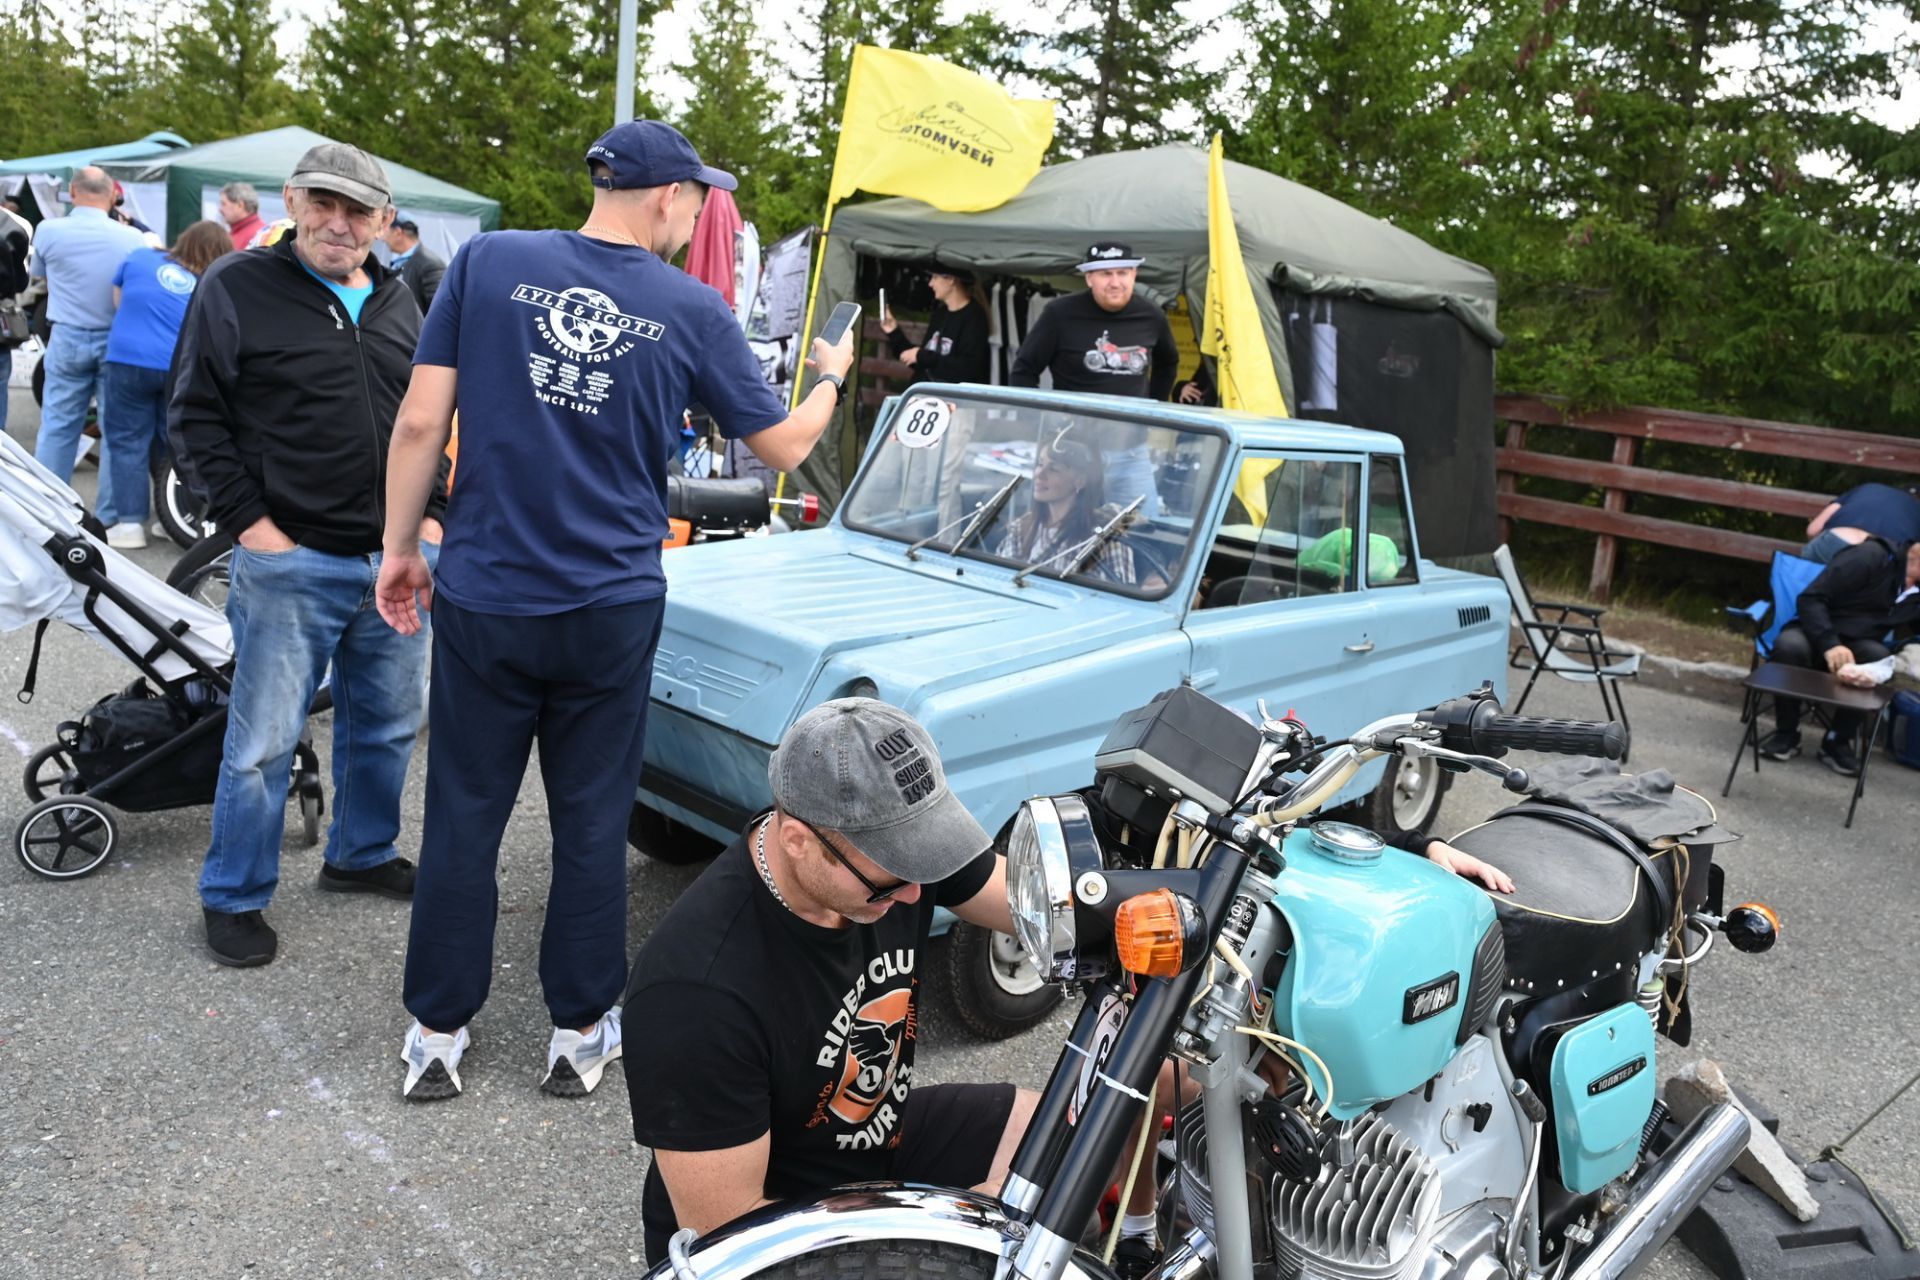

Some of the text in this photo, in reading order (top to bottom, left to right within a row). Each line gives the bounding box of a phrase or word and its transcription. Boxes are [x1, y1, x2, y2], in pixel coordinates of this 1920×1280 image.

[517, 287, 659, 336] LYLE & SCOTT
[534, 316, 635, 363] FOOTBALL FOR ALL
[570, 402, 598, 415] 1874
[907, 409, 939, 436] 88
[875, 727, 914, 761] OUT
[895, 757, 930, 788] SINCE
[816, 949, 914, 1069] RIDER CLU
[836, 1103, 898, 1150] TOUR
